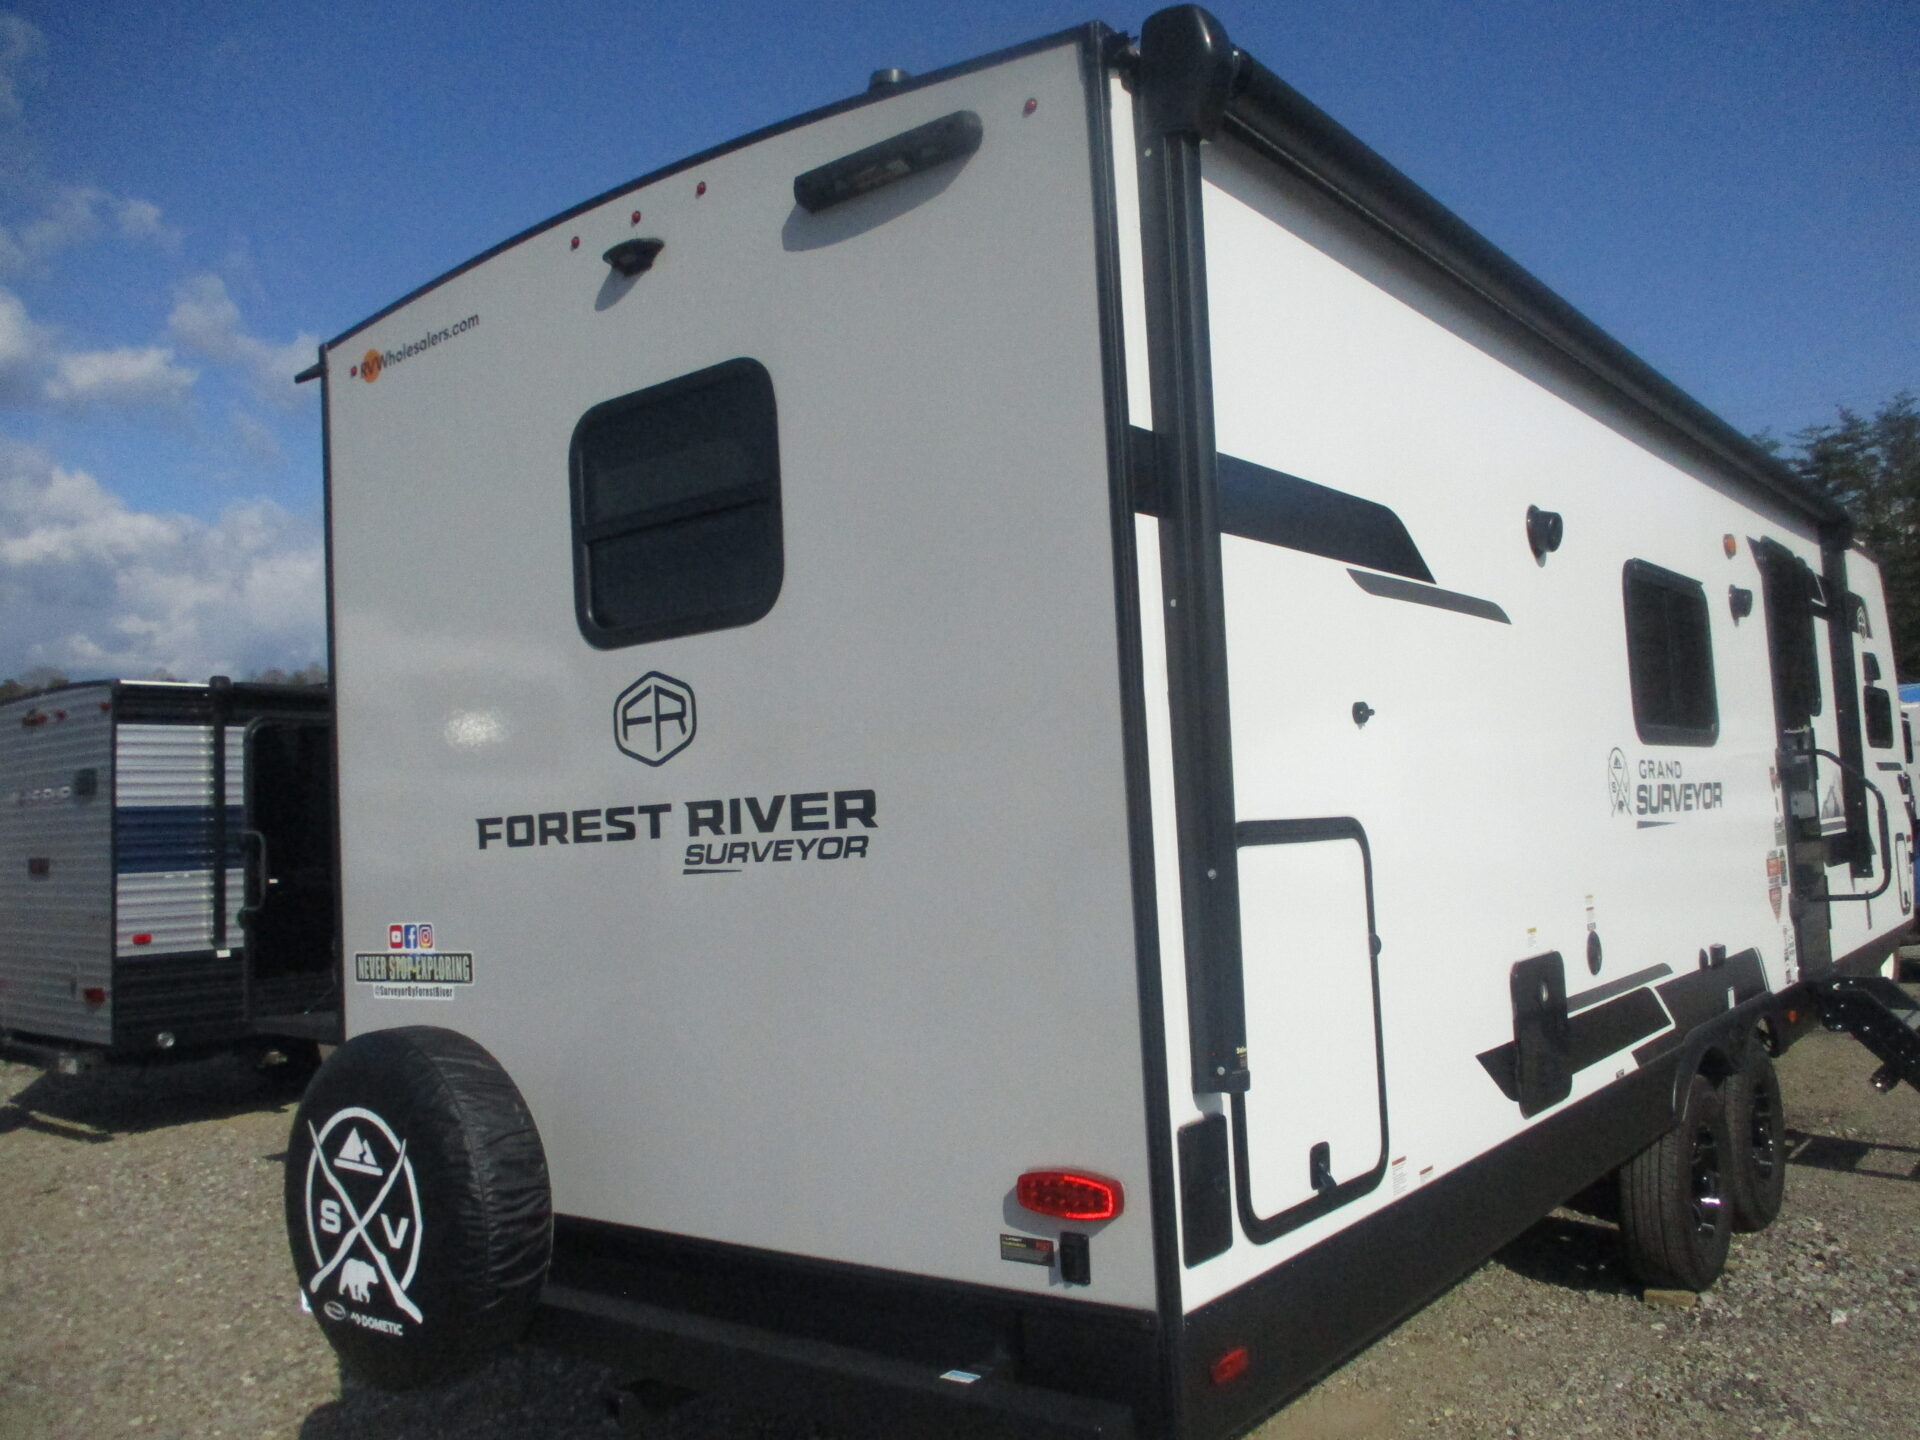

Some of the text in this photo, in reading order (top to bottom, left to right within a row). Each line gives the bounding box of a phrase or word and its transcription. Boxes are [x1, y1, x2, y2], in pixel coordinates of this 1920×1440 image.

[1638, 759, 1682, 779] GRAND
[1636, 782, 1723, 815] SURVEYOR
[475, 789, 879, 850] FOREST RIVER
[684, 835, 870, 866] SURVEYOR
[357, 956, 470, 981] NEVER STOP EXPLORING
[320, 1199, 410, 1250] S V
[361, 1314, 403, 1336] DOMETIC
